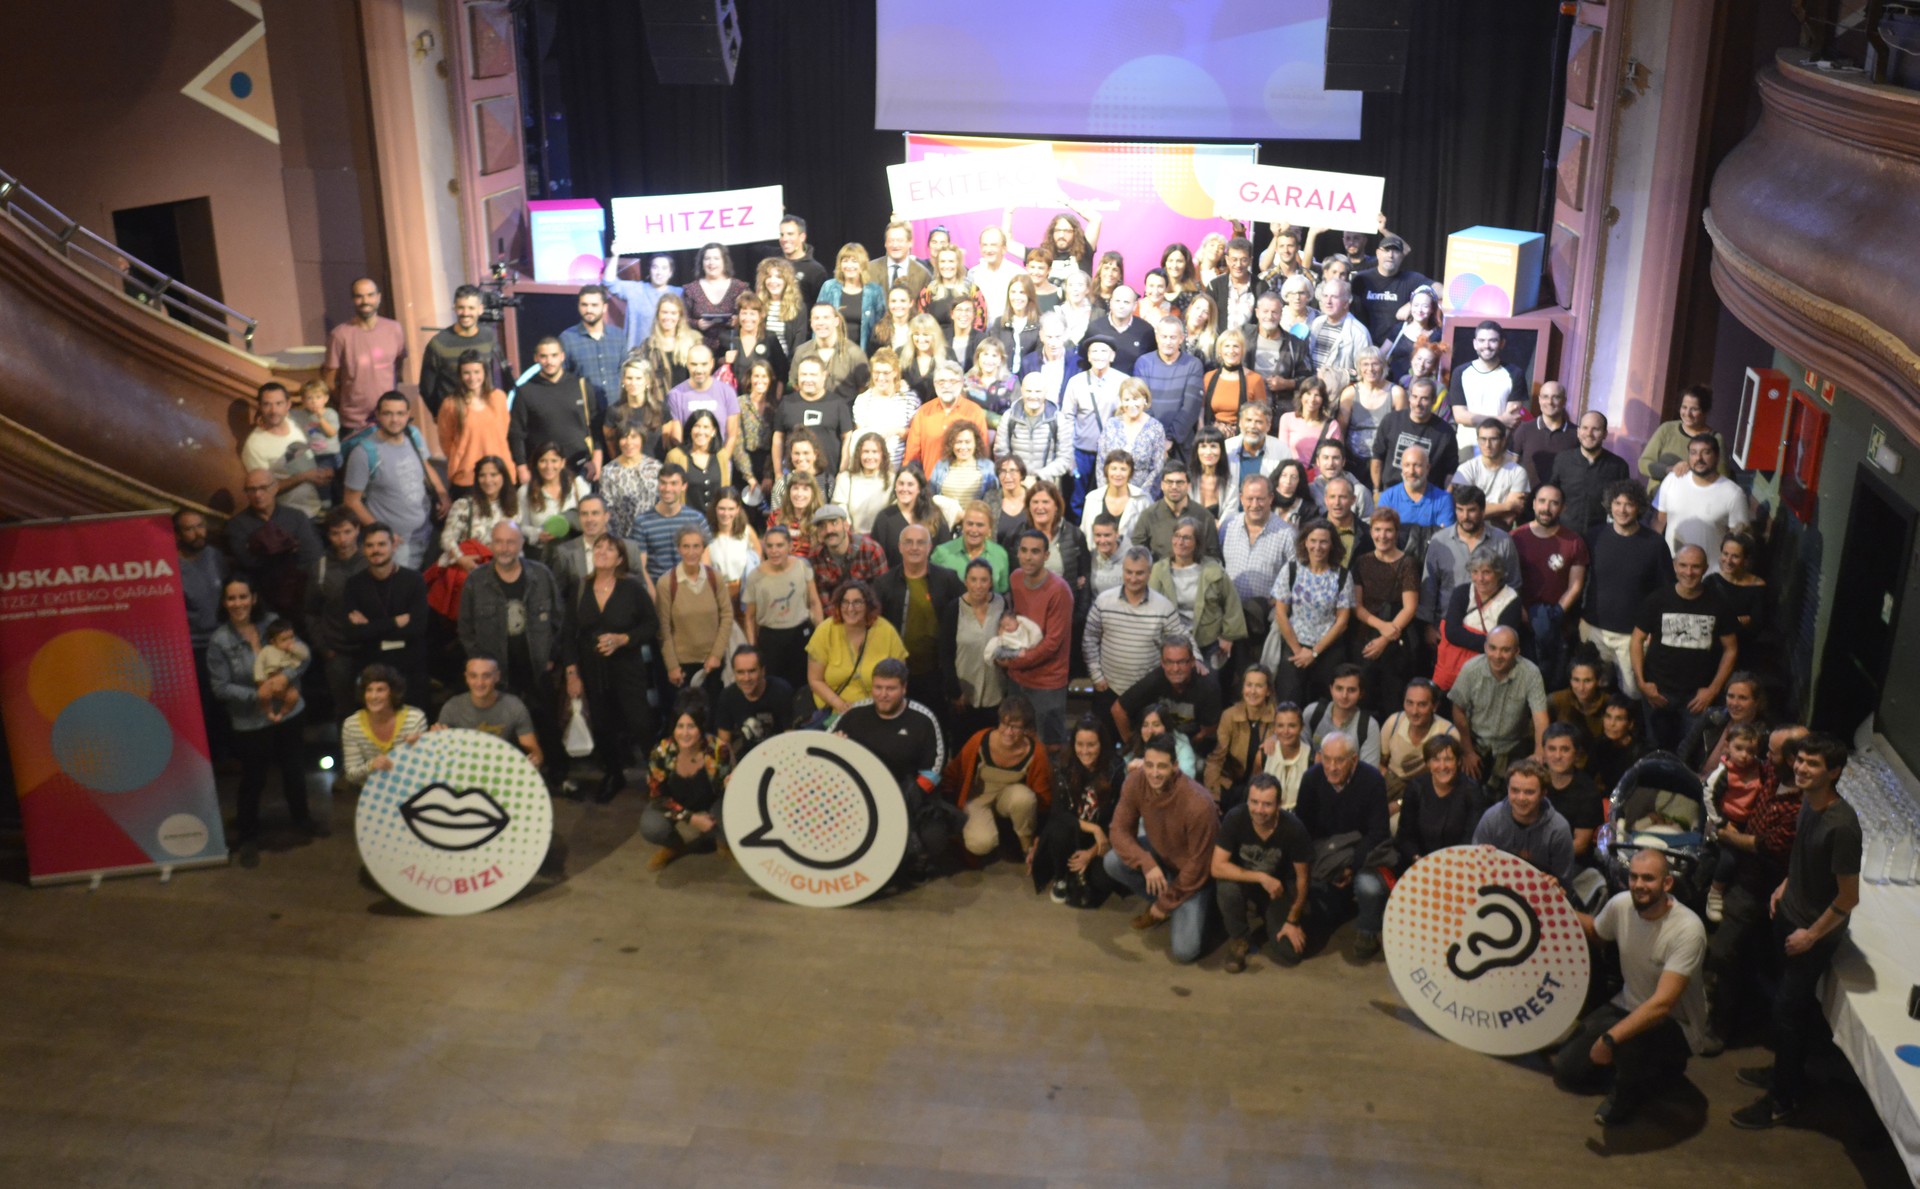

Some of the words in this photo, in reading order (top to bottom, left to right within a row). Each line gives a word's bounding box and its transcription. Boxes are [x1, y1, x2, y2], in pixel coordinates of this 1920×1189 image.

[1240, 182, 1356, 213] GARAIA
[645, 206, 754, 234] HITZEZ
[43, 588, 109, 606] EKITEKO
[113, 583, 174, 599] GARAIA
